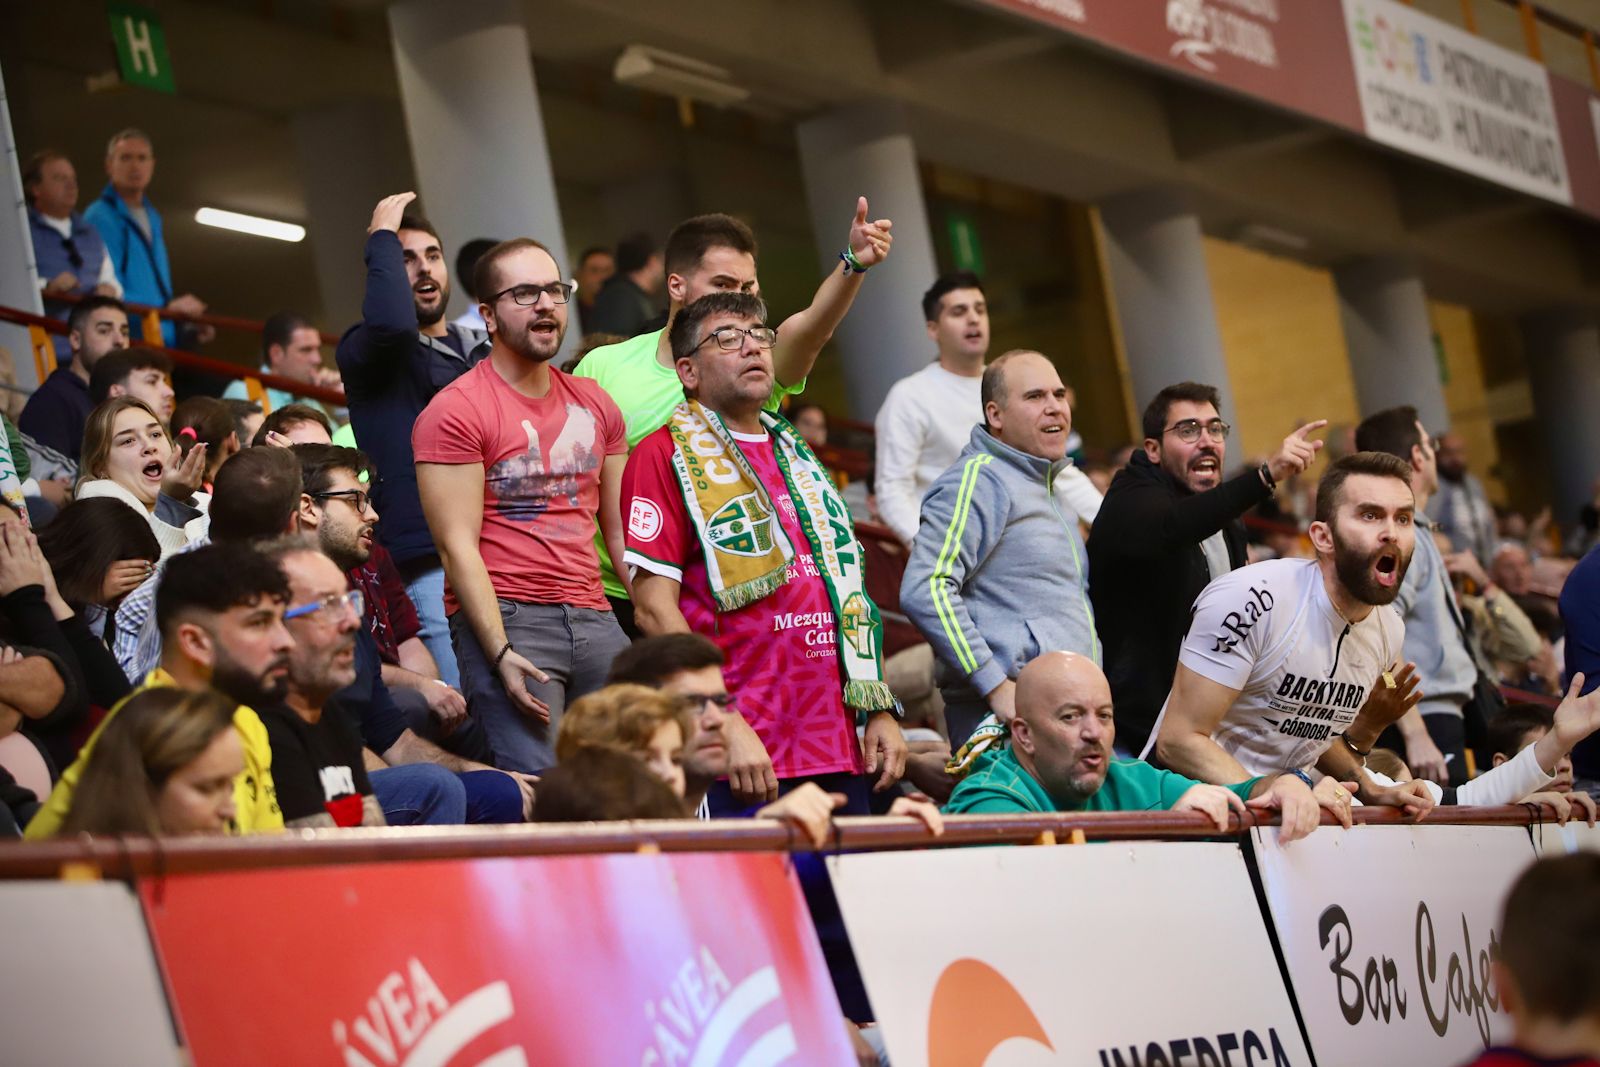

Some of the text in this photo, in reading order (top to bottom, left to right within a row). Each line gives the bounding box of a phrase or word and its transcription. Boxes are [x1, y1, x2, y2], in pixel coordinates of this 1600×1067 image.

[123, 15, 158, 77] H
[795, 470, 840, 578] HUMANIDAD
[800, 554, 814, 565] PA
[1220, 585, 1275, 643] Rab
[1276, 673, 1365, 709] BACKYARD
[1297, 705, 1336, 721] ULTRA
[1279, 717, 1332, 741] CÓRDOBA
[1318, 903, 1407, 1026] Bar
